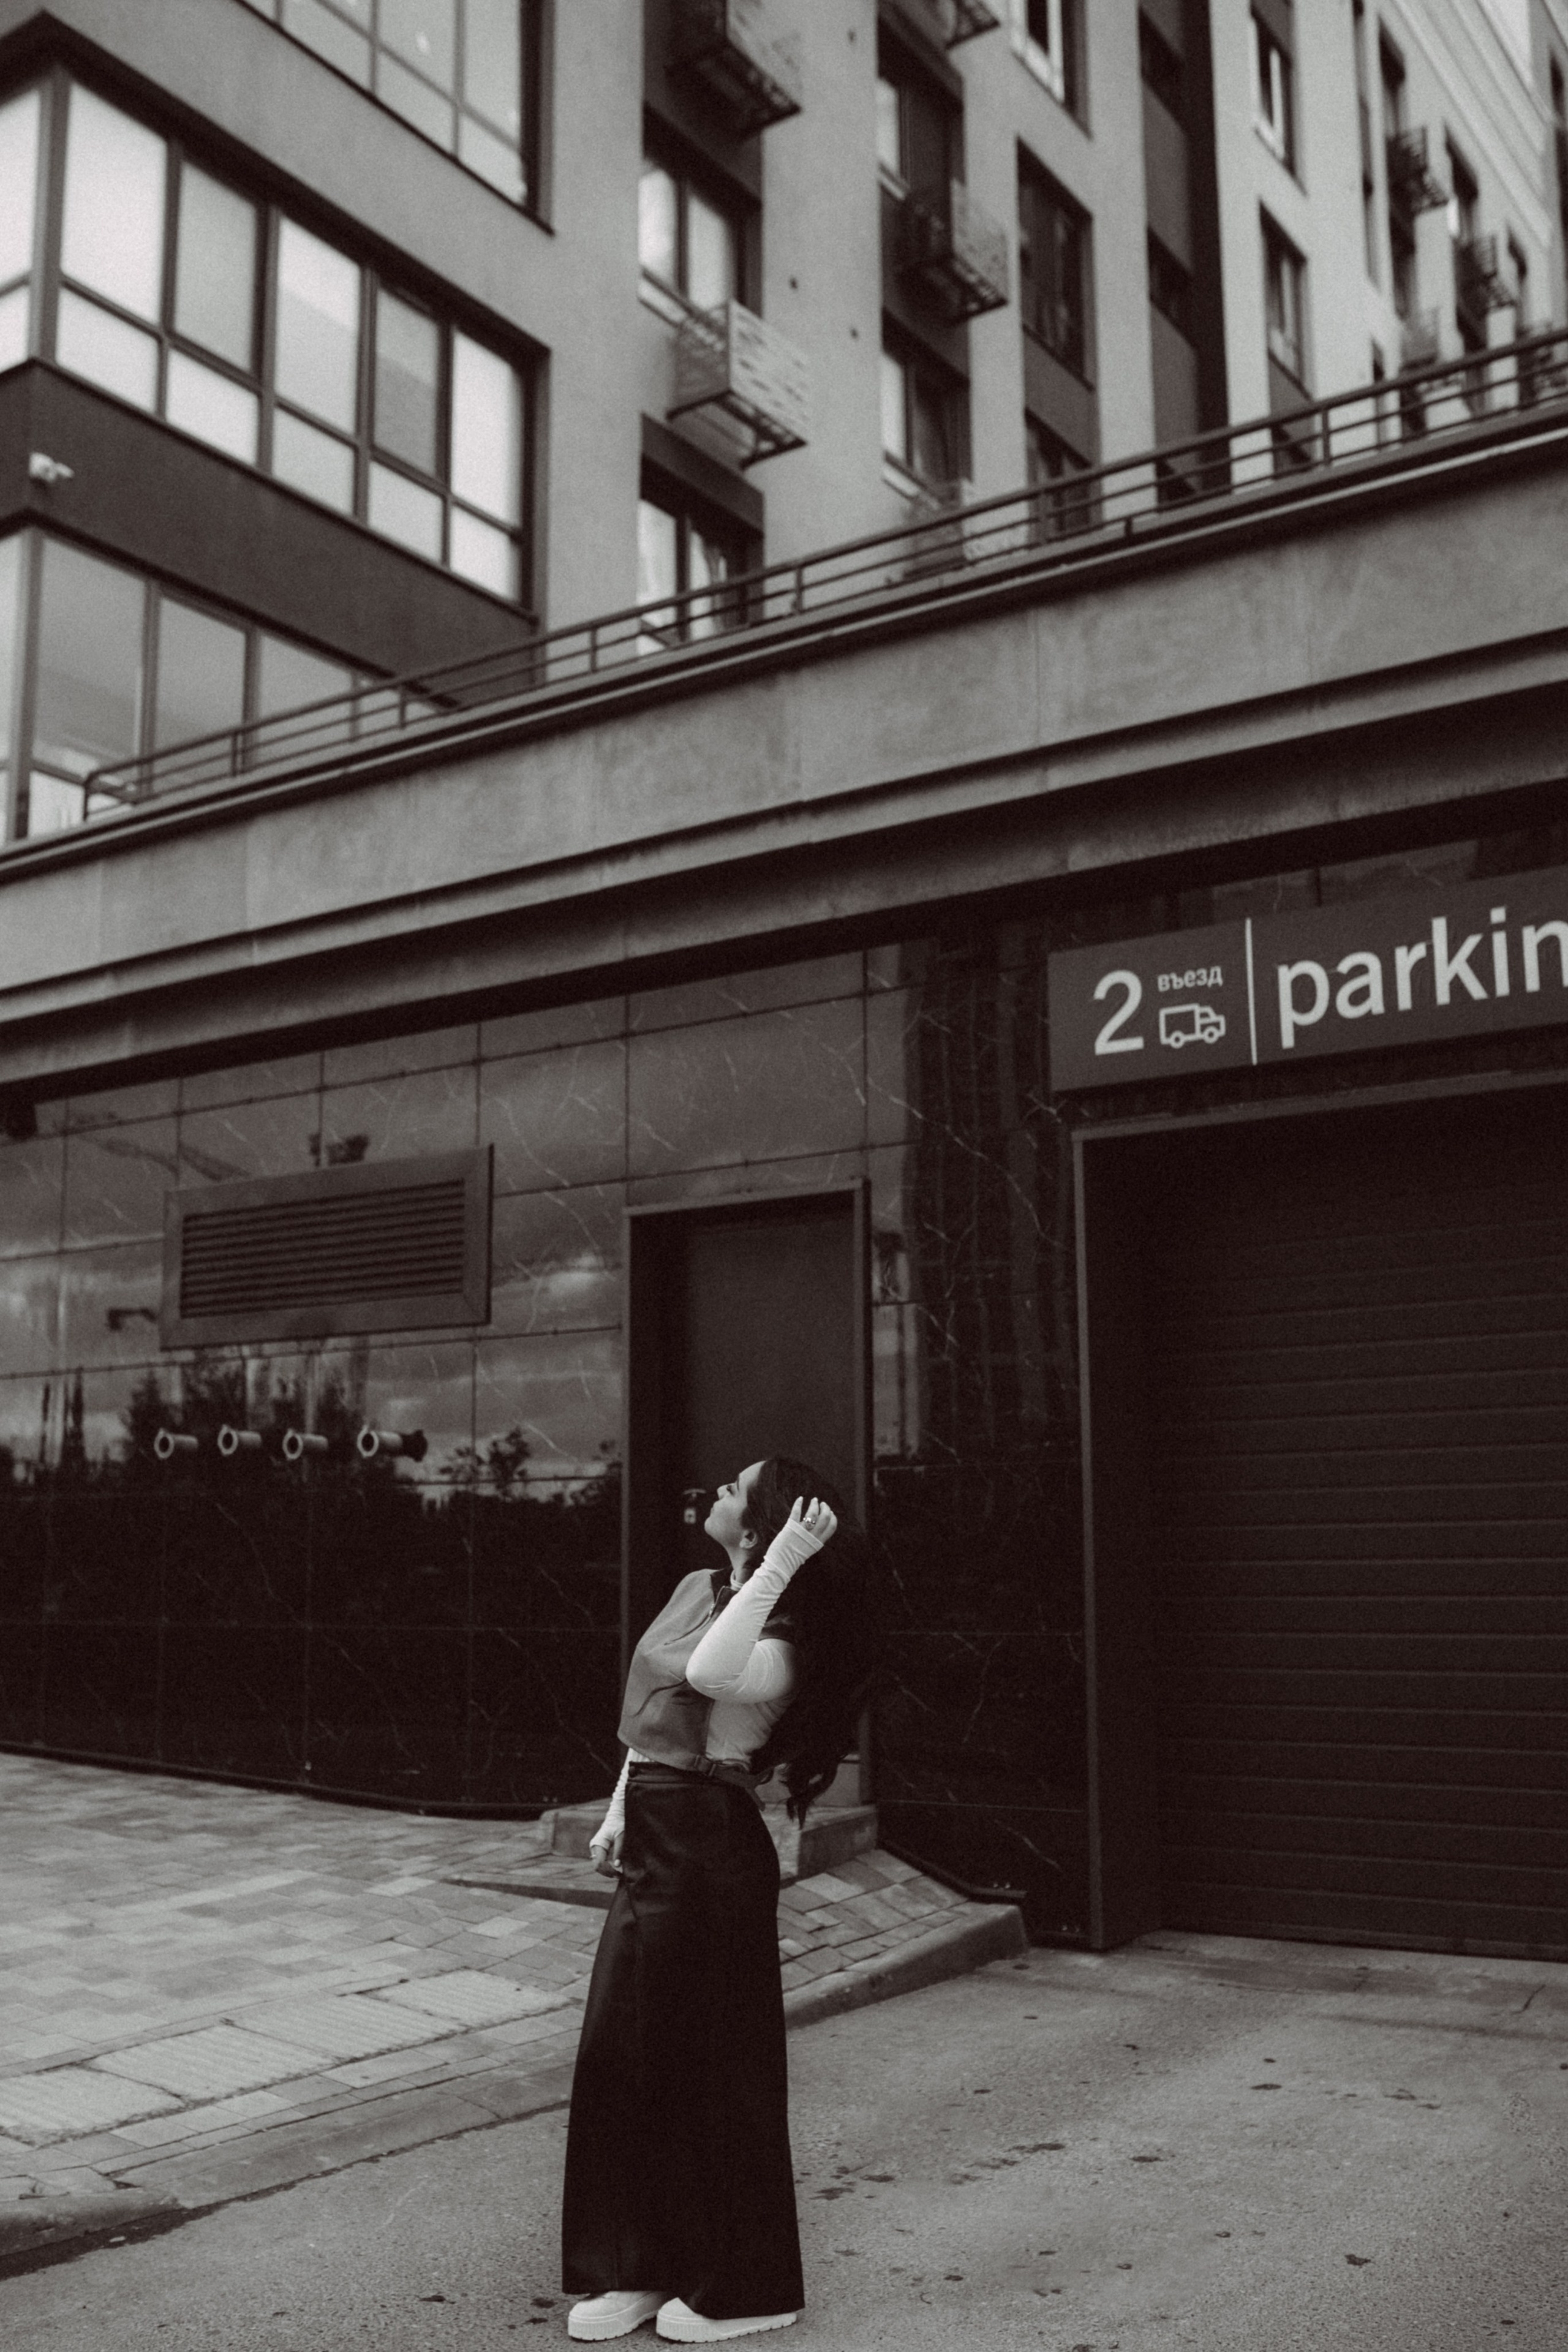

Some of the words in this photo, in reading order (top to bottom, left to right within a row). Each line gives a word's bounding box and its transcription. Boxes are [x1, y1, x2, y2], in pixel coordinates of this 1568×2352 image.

[1093, 970, 1144, 1055] 2
[1157, 965, 1223, 992] въезд
[1277, 907, 1568, 1049] parkin
